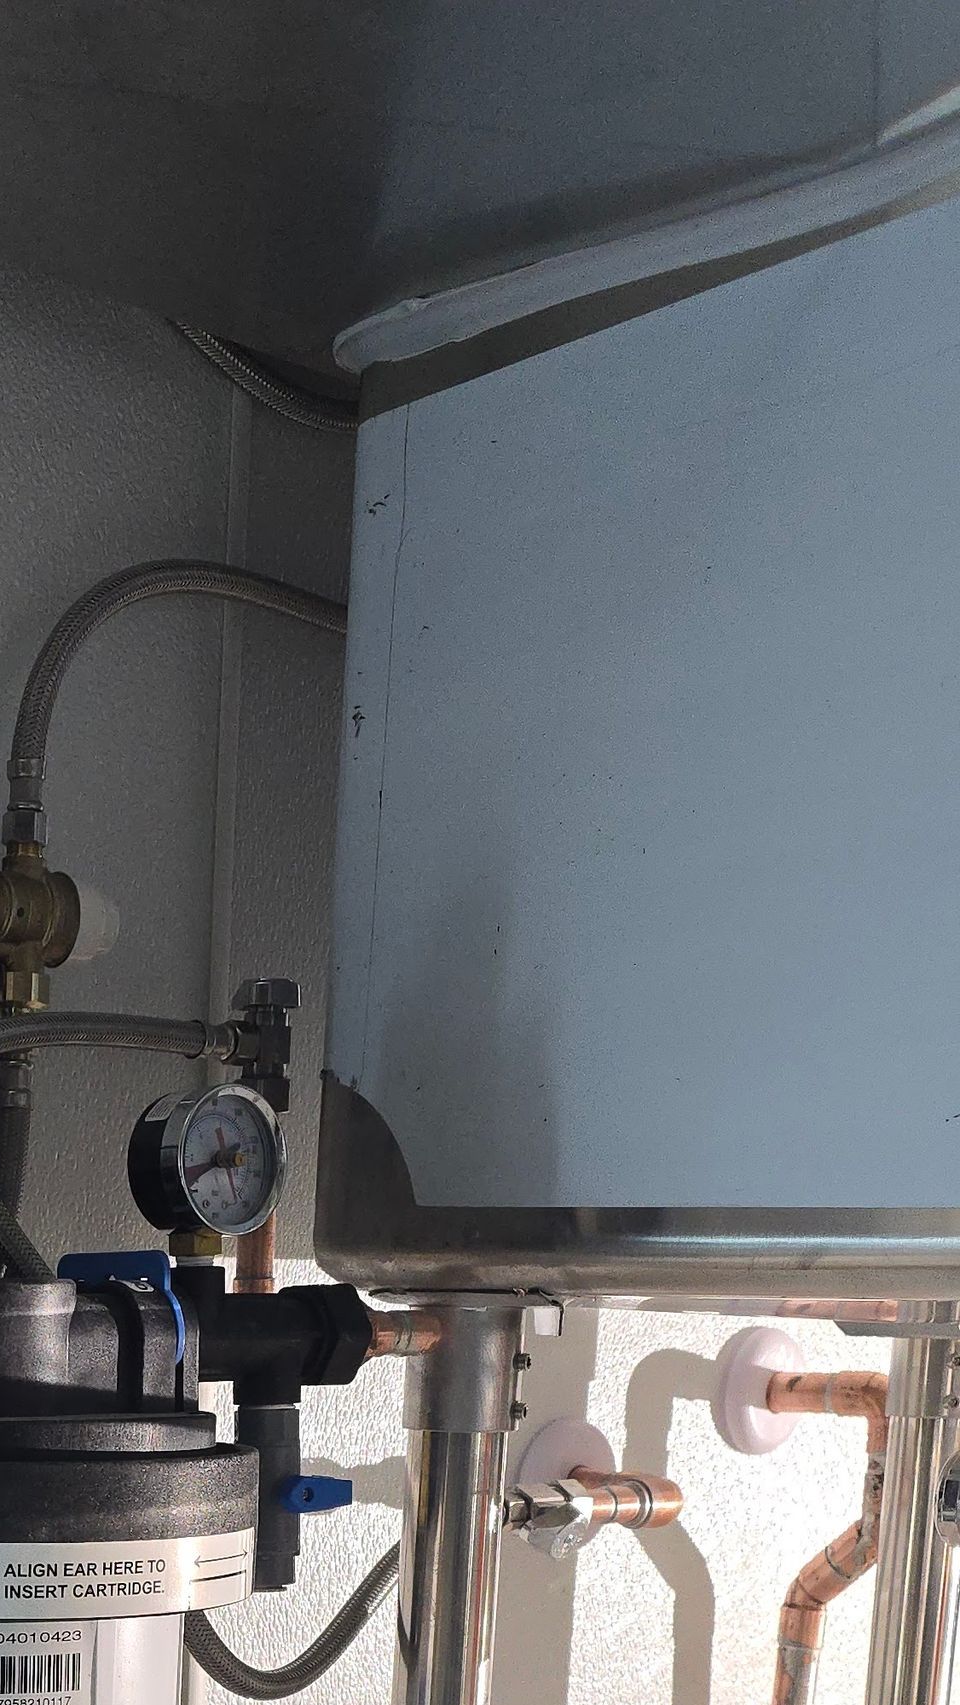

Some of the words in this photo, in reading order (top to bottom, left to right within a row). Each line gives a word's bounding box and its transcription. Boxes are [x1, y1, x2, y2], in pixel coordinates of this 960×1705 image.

[3, 1563, 58, 1577] ALIGN
[63, 1562, 98, 1577] EAR
[102, 1560, 144, 1575] HERE
[148, 1559, 166, 1573] TO
[4, 1584, 68, 1599] INSERT
[72, 1580, 165, 1598] CARTRIDGE.
